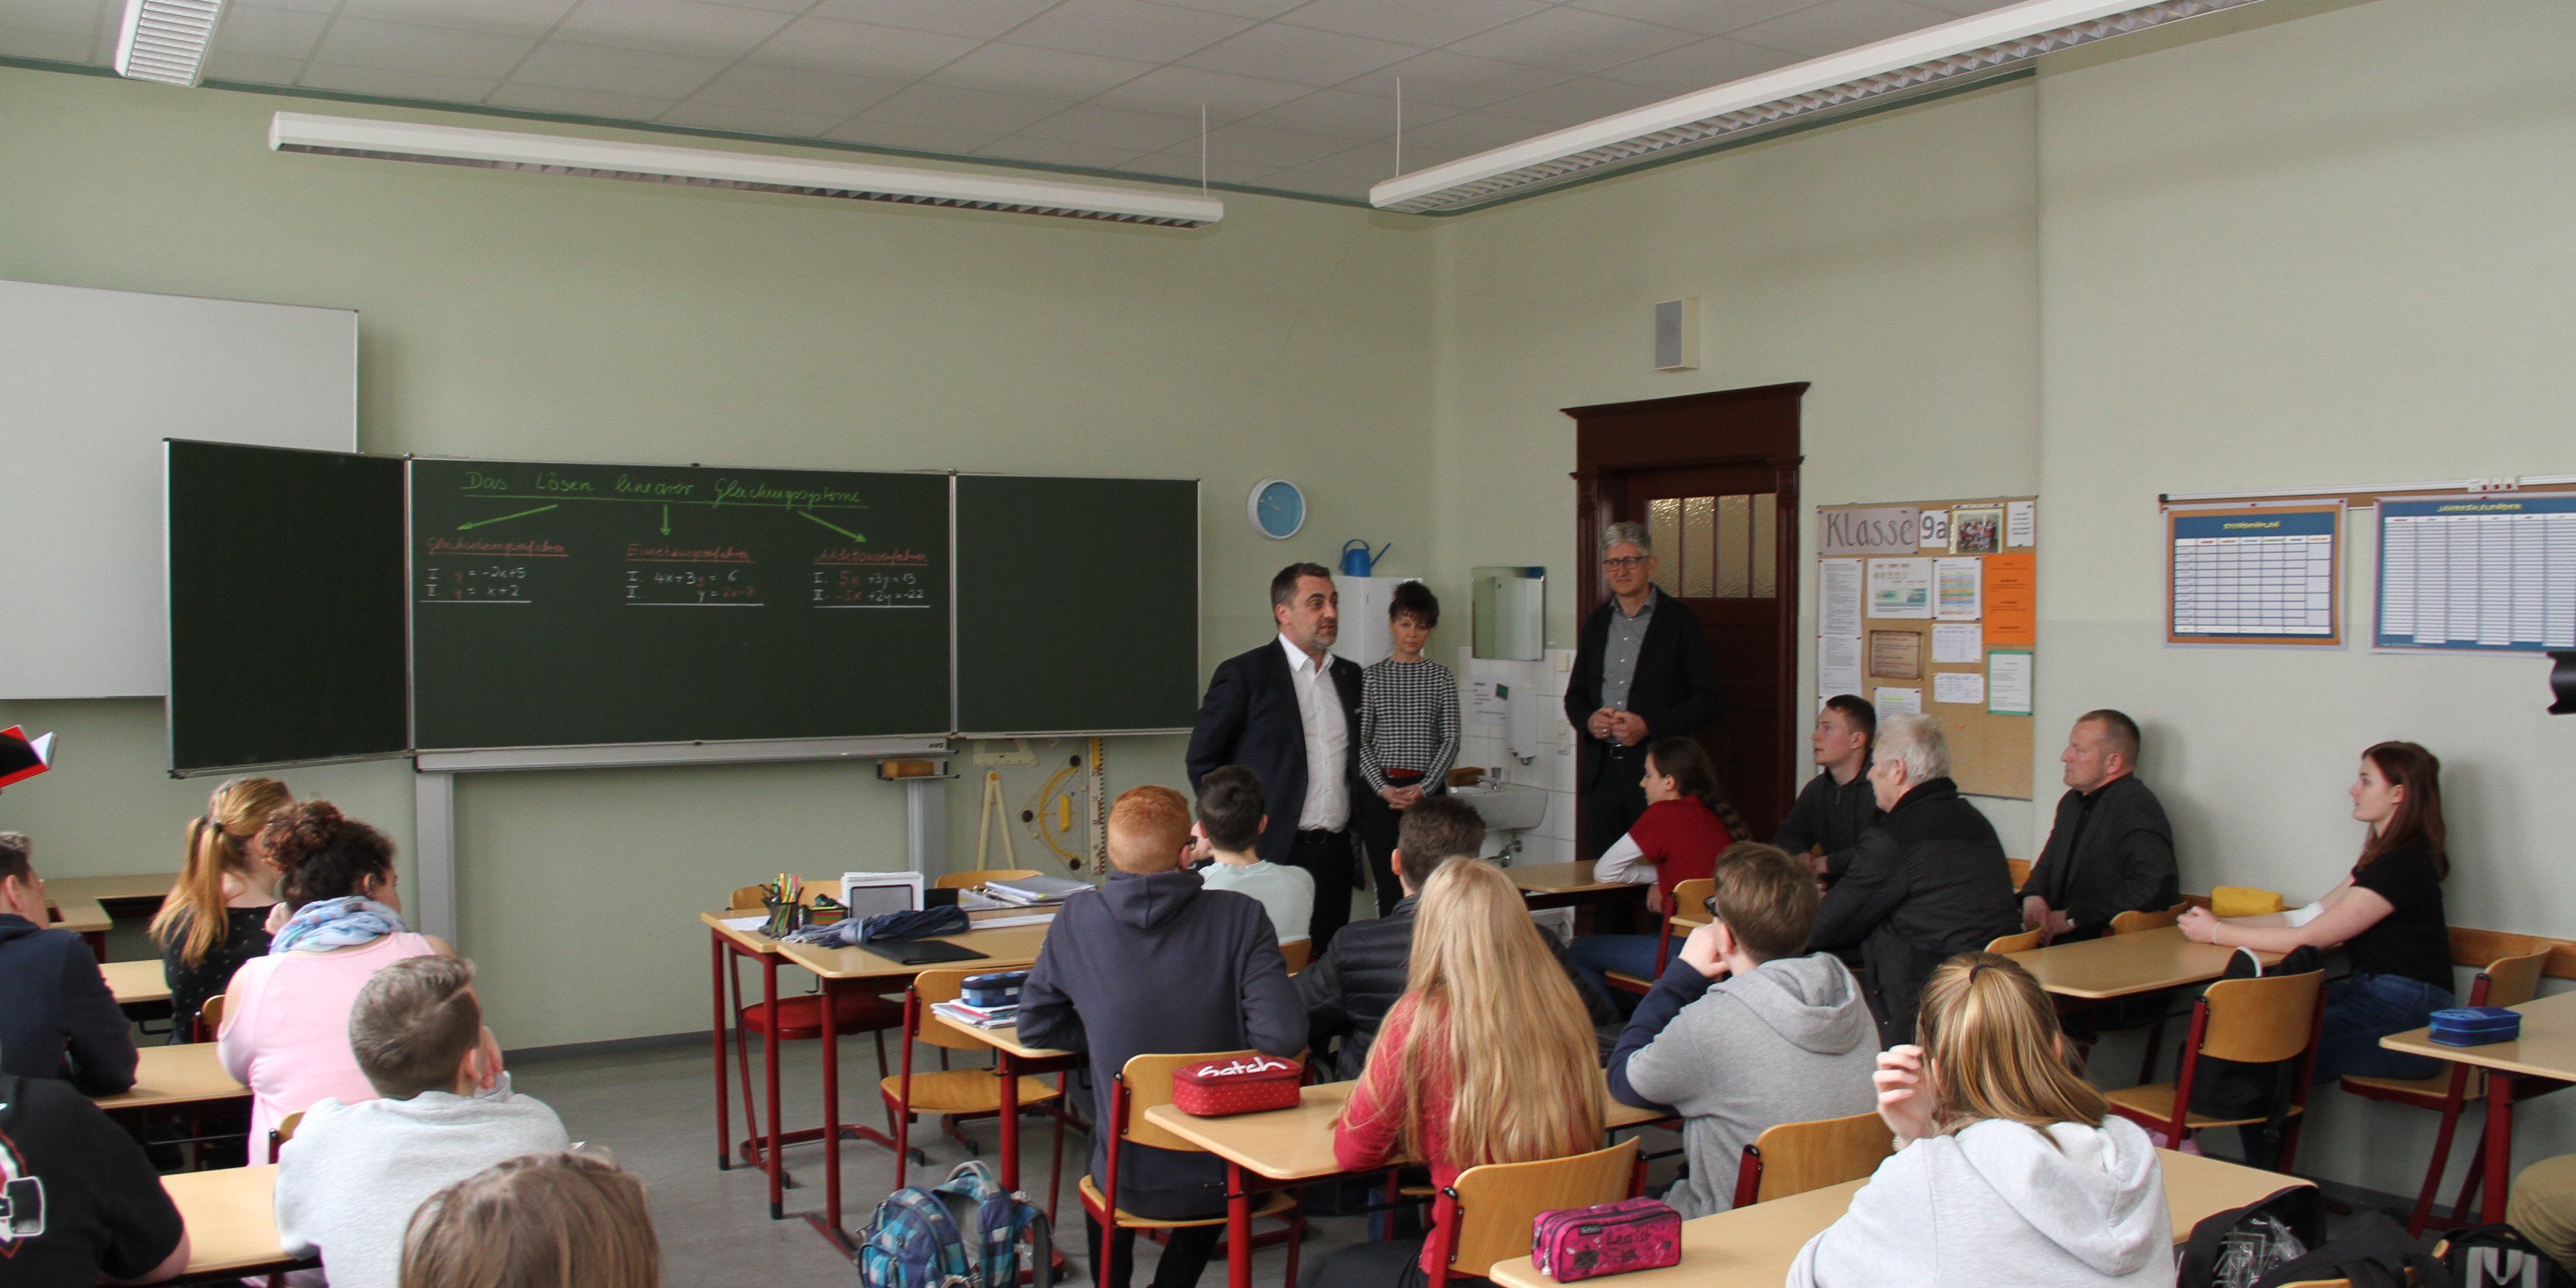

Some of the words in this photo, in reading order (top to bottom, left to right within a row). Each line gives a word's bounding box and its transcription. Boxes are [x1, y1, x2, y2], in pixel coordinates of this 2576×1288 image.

[461, 470, 508, 490] Das
[536, 471, 595, 492] Lösen
[1826, 512, 1914, 548] Klasse
[1921, 514, 1947, 540] 9a
[727, 569, 740, 582] 6
